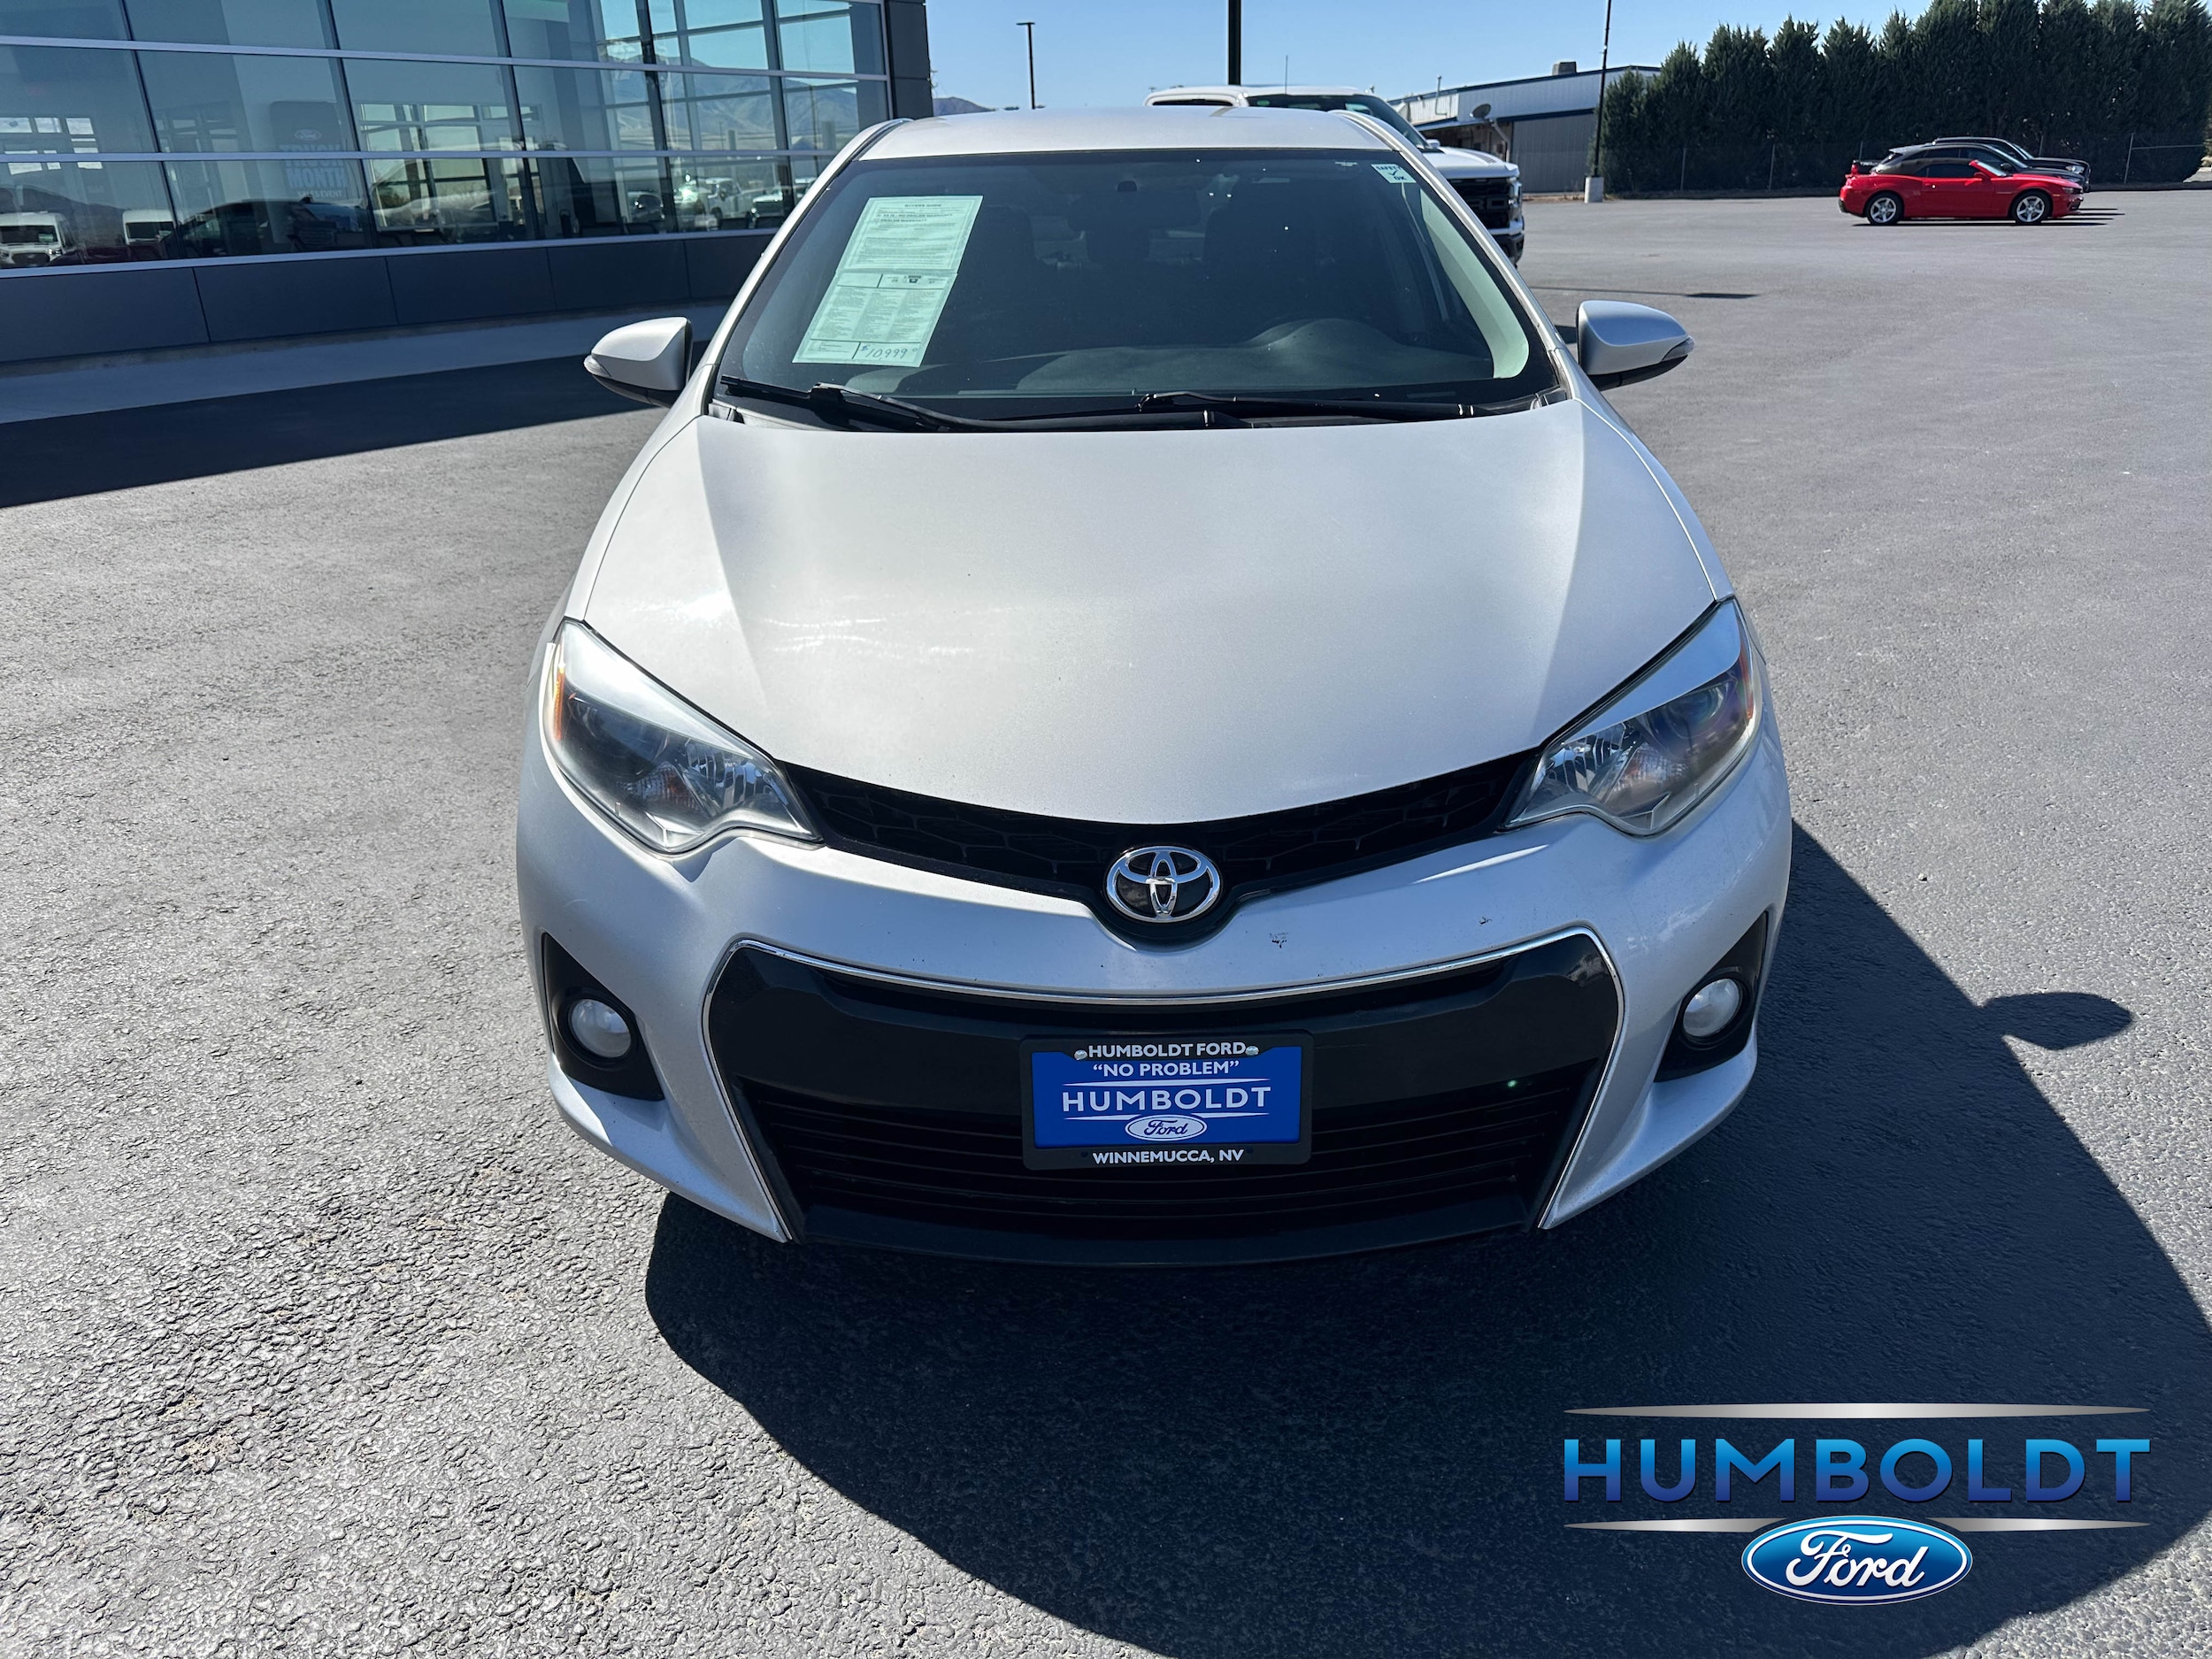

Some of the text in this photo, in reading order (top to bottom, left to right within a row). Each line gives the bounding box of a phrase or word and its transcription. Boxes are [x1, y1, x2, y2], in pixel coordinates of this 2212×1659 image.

[286, 168, 348, 188] MONTH
[1088, 1041, 1247, 1058] HUMBOLDT FORD
[1093, 1060, 1240, 1078] “NO PROBLEM”
[1062, 1086, 1271, 1112] HUMBOLDT
[1143, 1119, 1188, 1136] Ford
[1093, 1149, 1244, 1164] WINNEMUCCA, NV
